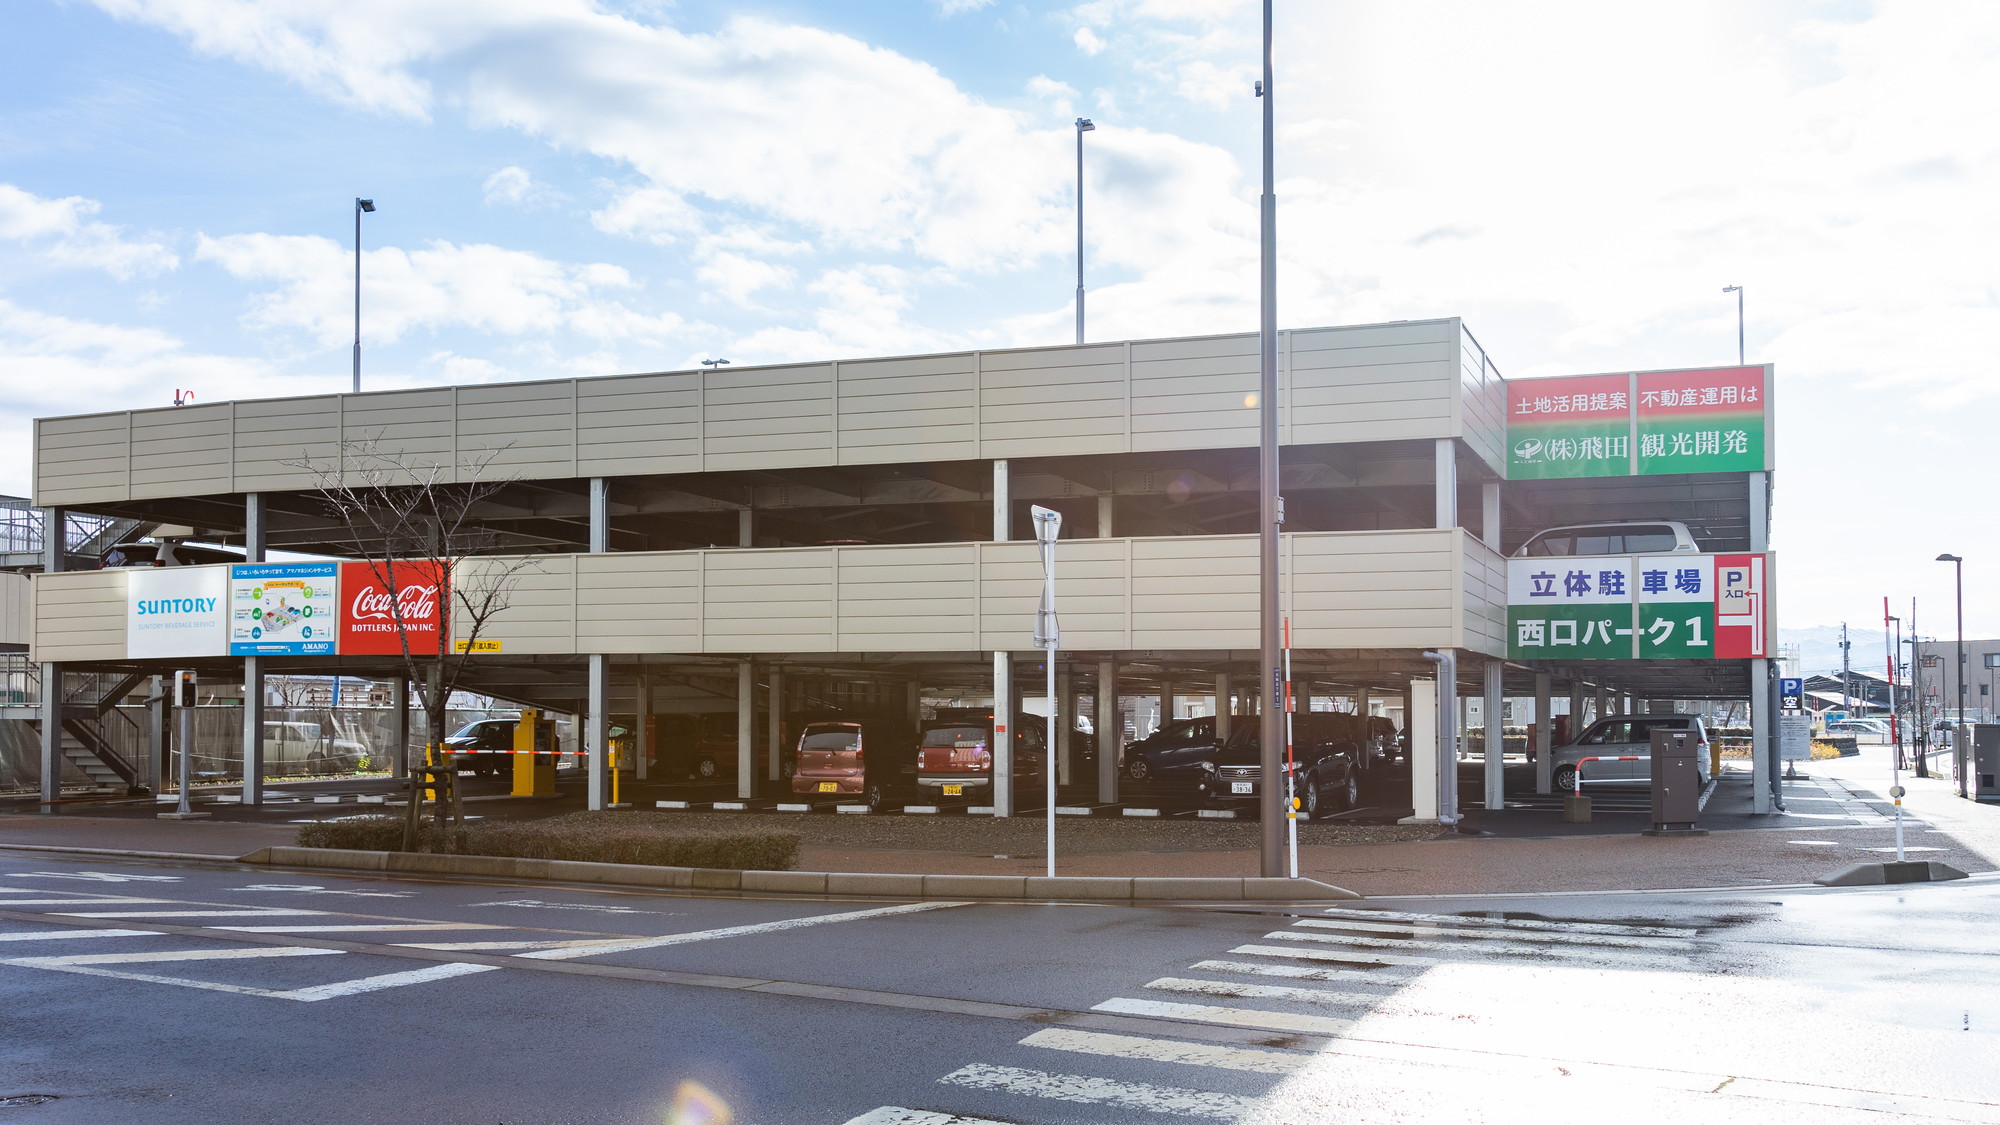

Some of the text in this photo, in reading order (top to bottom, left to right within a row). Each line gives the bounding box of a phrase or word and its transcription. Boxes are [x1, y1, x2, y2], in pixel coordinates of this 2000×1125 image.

[1514, 385, 1759, 416] 土地活用提案 不動産運用は
[1529, 568, 1702, 598] 立体駐車場
[1726, 570, 1743, 587] P
[1724, 589, 1744, 599] 入口
[352, 585, 438, 620] CocaCola
[138, 619, 215, 631] SUNTORY BEVERAGE SERVICE
[352, 623, 392, 632] BOTTLERS
[301, 642, 329, 650] AMANO
[1784, 679, 1797, 694] P
[1783, 695, 1798, 709] 空
